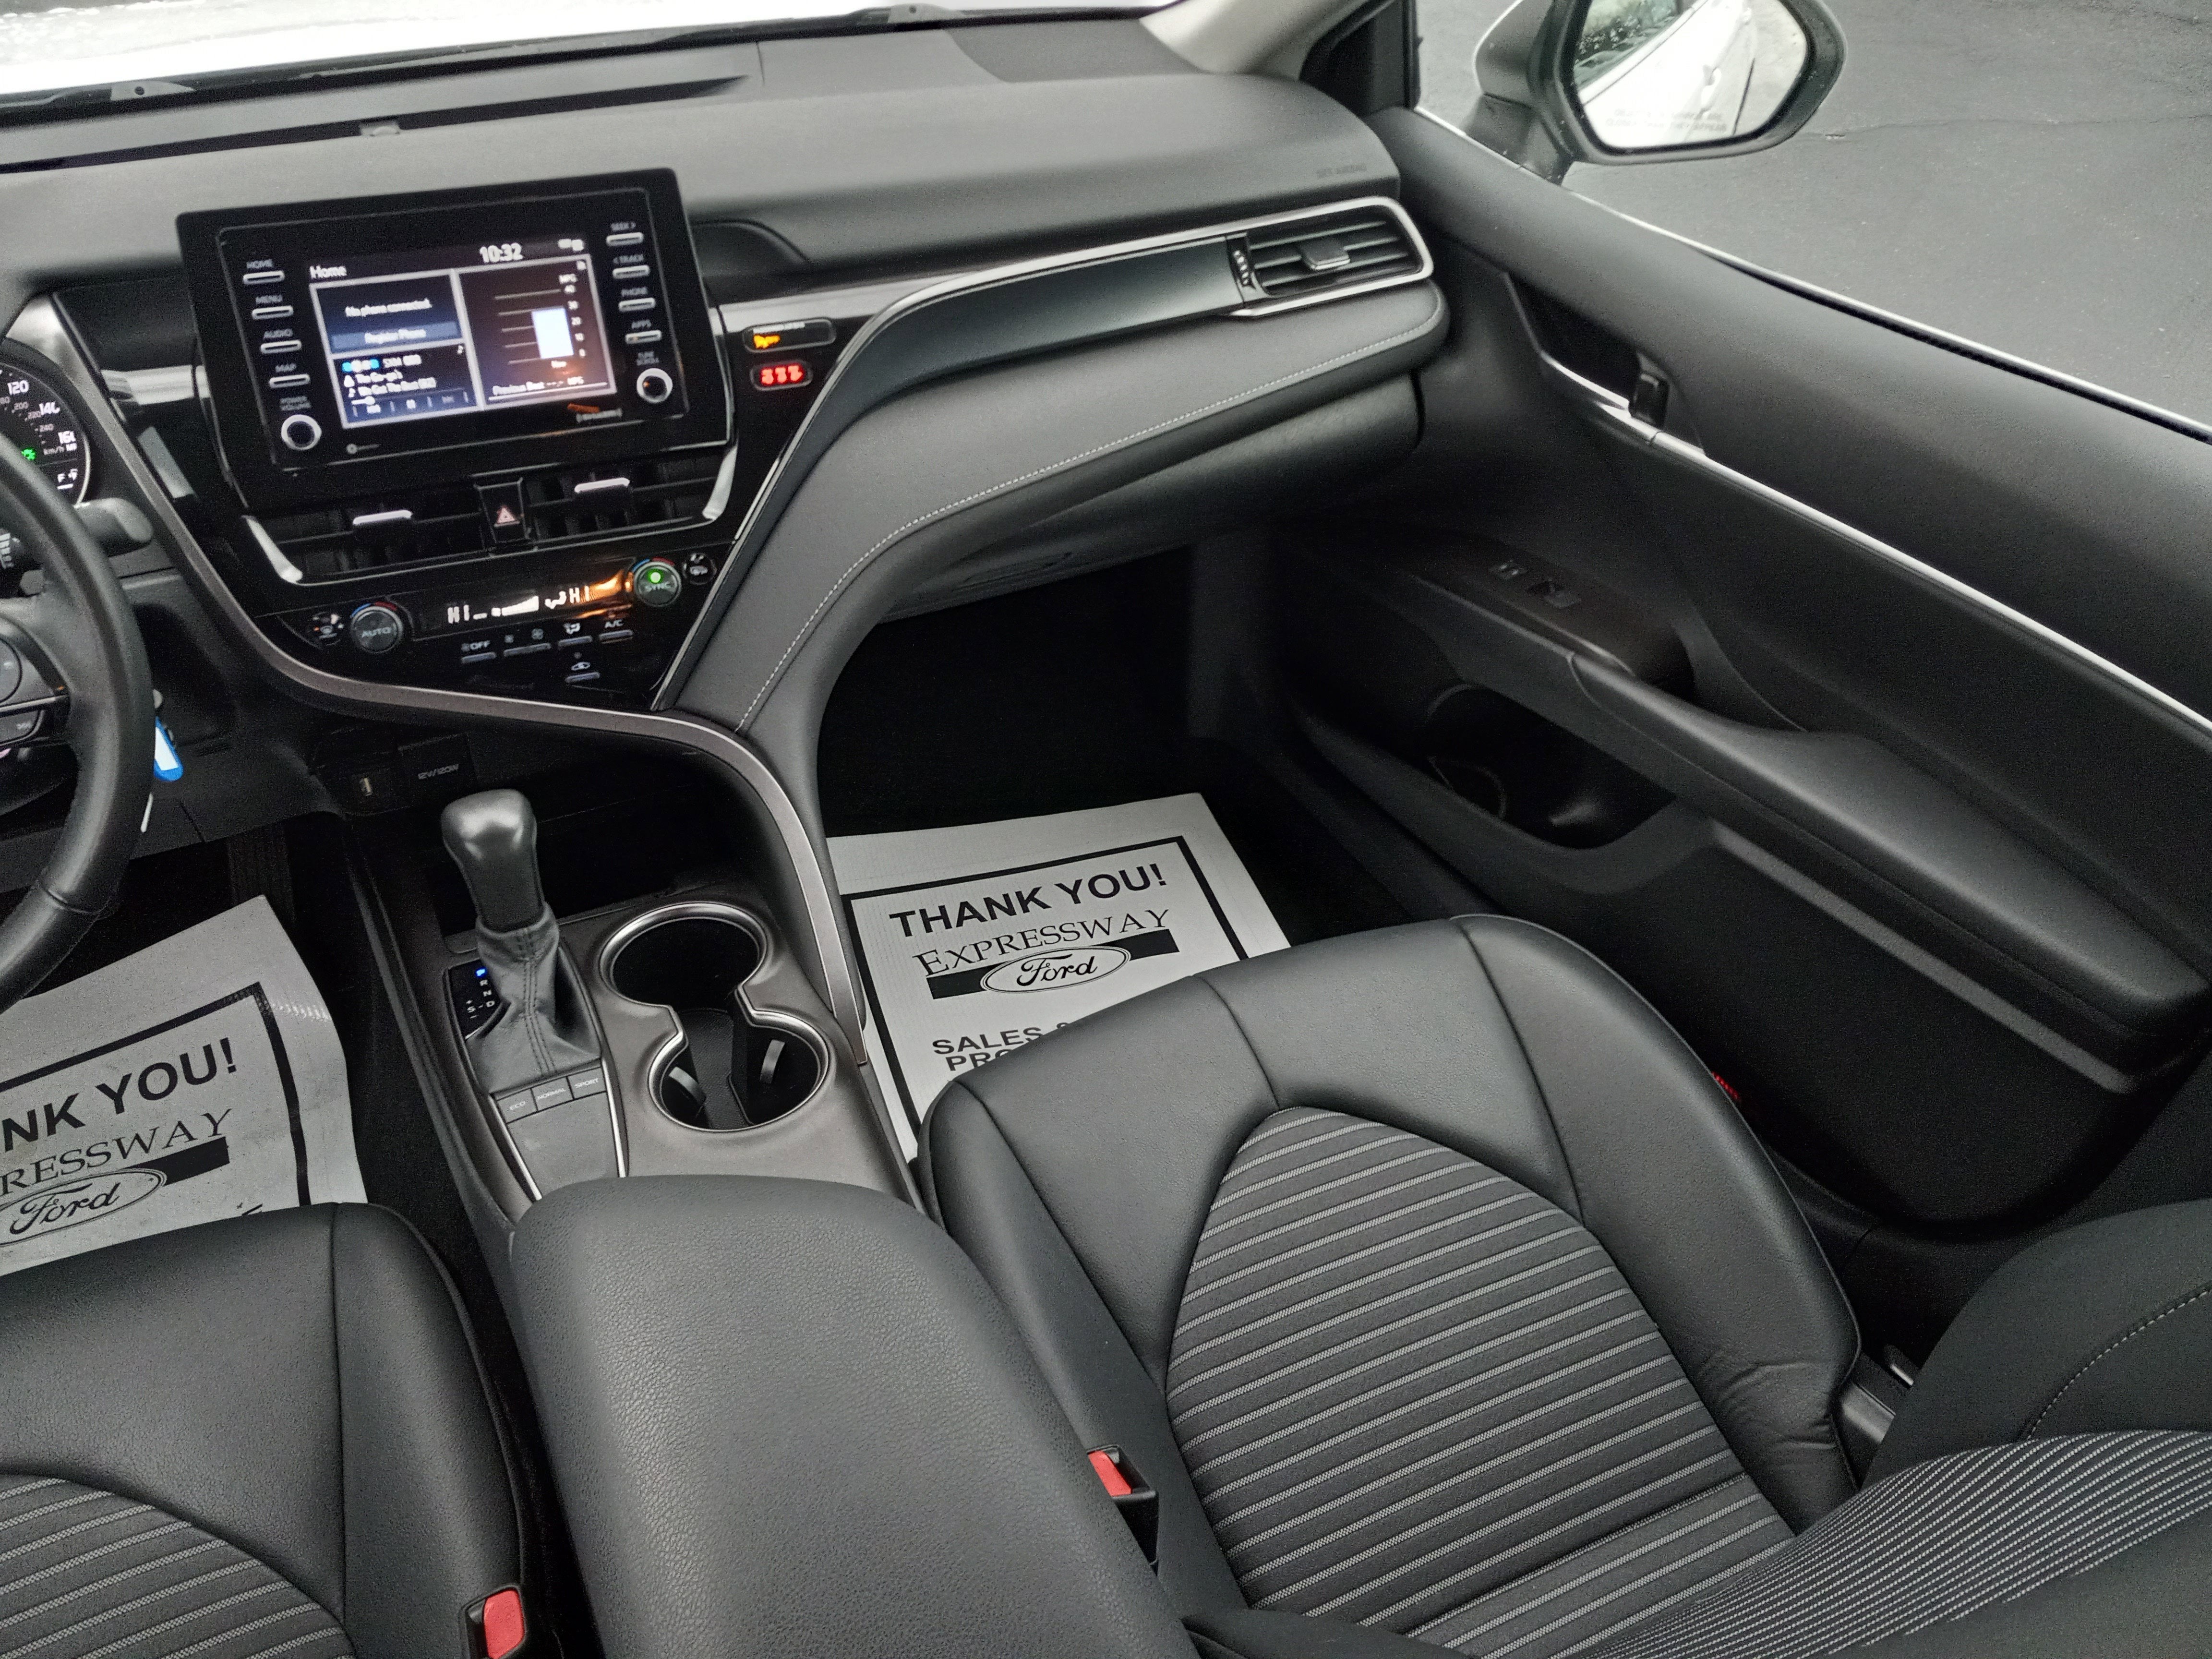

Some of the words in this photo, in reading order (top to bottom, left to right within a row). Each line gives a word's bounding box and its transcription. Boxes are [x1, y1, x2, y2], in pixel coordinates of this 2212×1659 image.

[480, 243, 522, 263] 10:32
[310, 266, 347, 278] Home
[7, 380, 29, 395] 120
[14, 401, 29, 410] 200
[645, 582, 671, 592] SYNC
[447, 605, 470, 624] HI
[604, 619, 624, 628] A/C
[361, 627, 392, 637] AUTO
[469, 640, 491, 650] OFF
[889, 887, 1052, 938] THANK
[1055, 864, 1167, 904] YOU!
[913, 909, 1169, 977] EXPRESSWAY
[1016, 954, 1097, 986] Ford
[932, 1027, 1045, 1055] SALES
[95, 1037, 237, 1115] YOU!
[575, 1078, 599, 1088] SPORT
[537, 1088, 567, 1101] NORMAL
[509, 1101, 526, 1110] ECO
[10, 1183, 121, 1235] Ford
